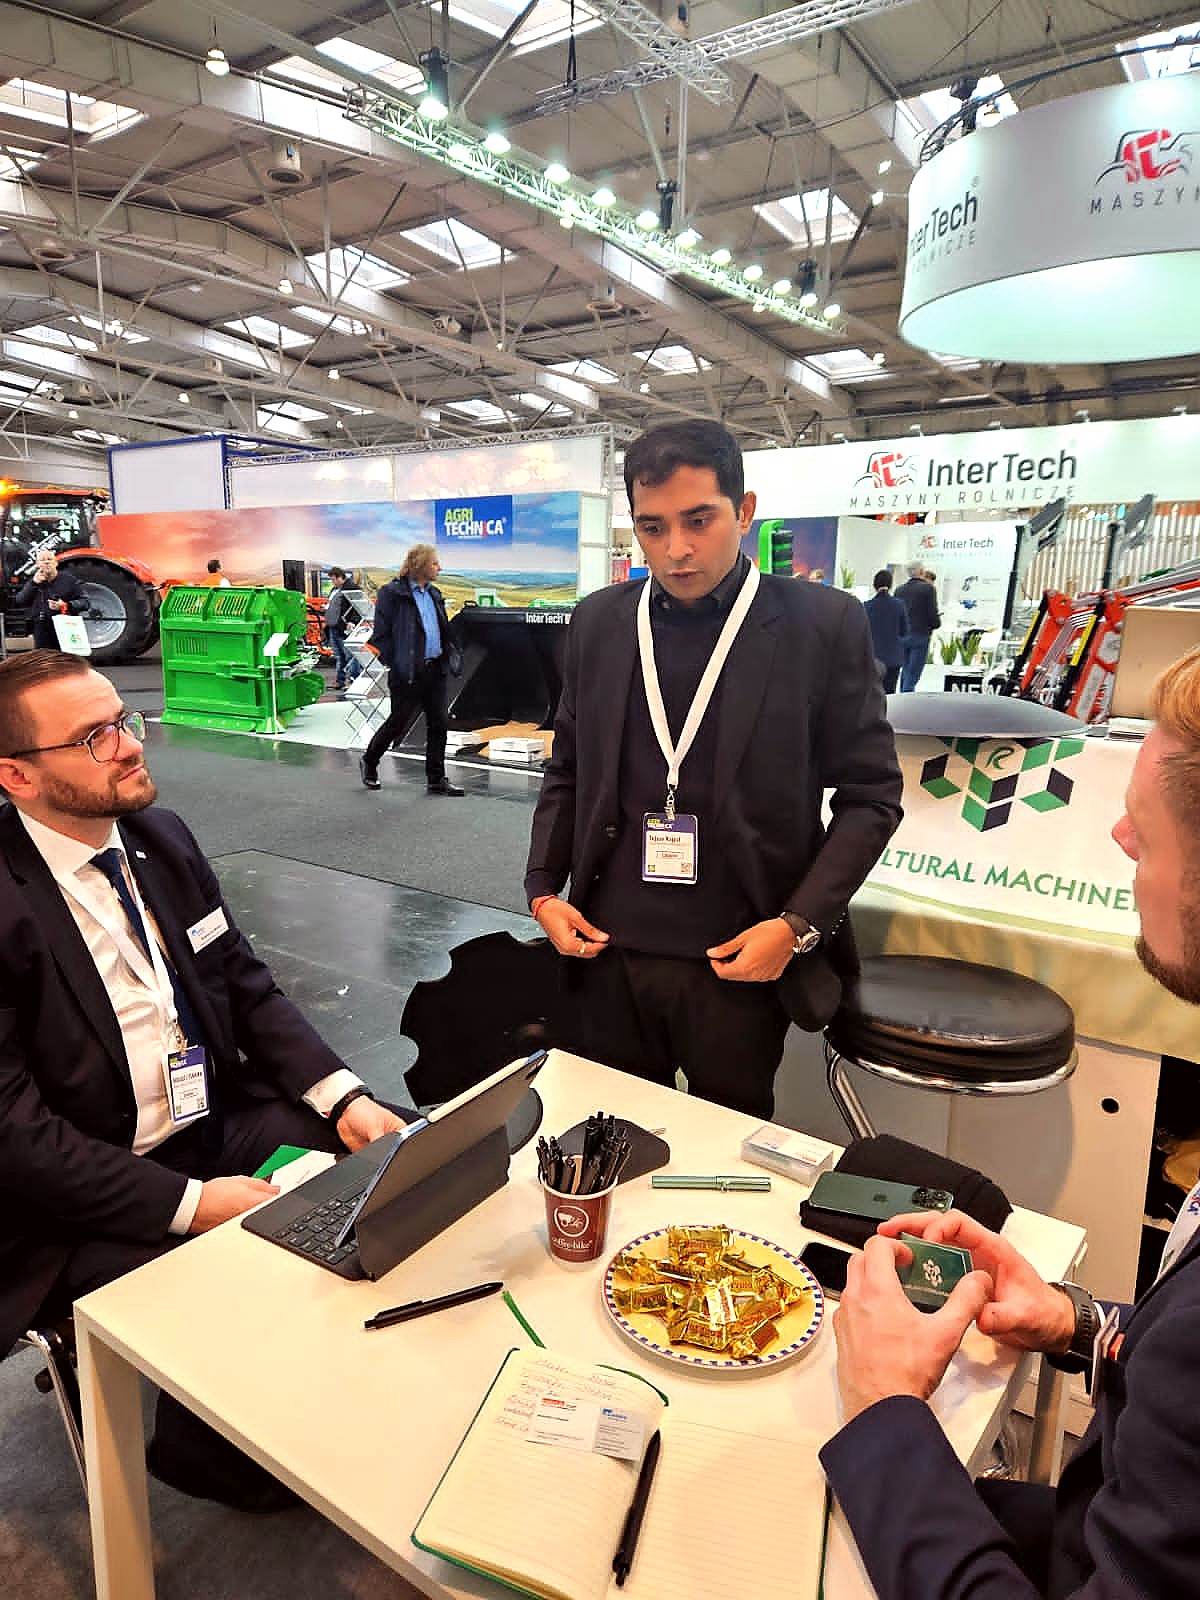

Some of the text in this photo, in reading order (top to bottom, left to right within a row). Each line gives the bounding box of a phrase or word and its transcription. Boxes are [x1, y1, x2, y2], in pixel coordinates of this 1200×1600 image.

[850, 485, 1075, 508] MASZYNY ROLNICZE
[445, 507, 473, 522] AGRI
[984, 864, 1138, 912] MACHINE
